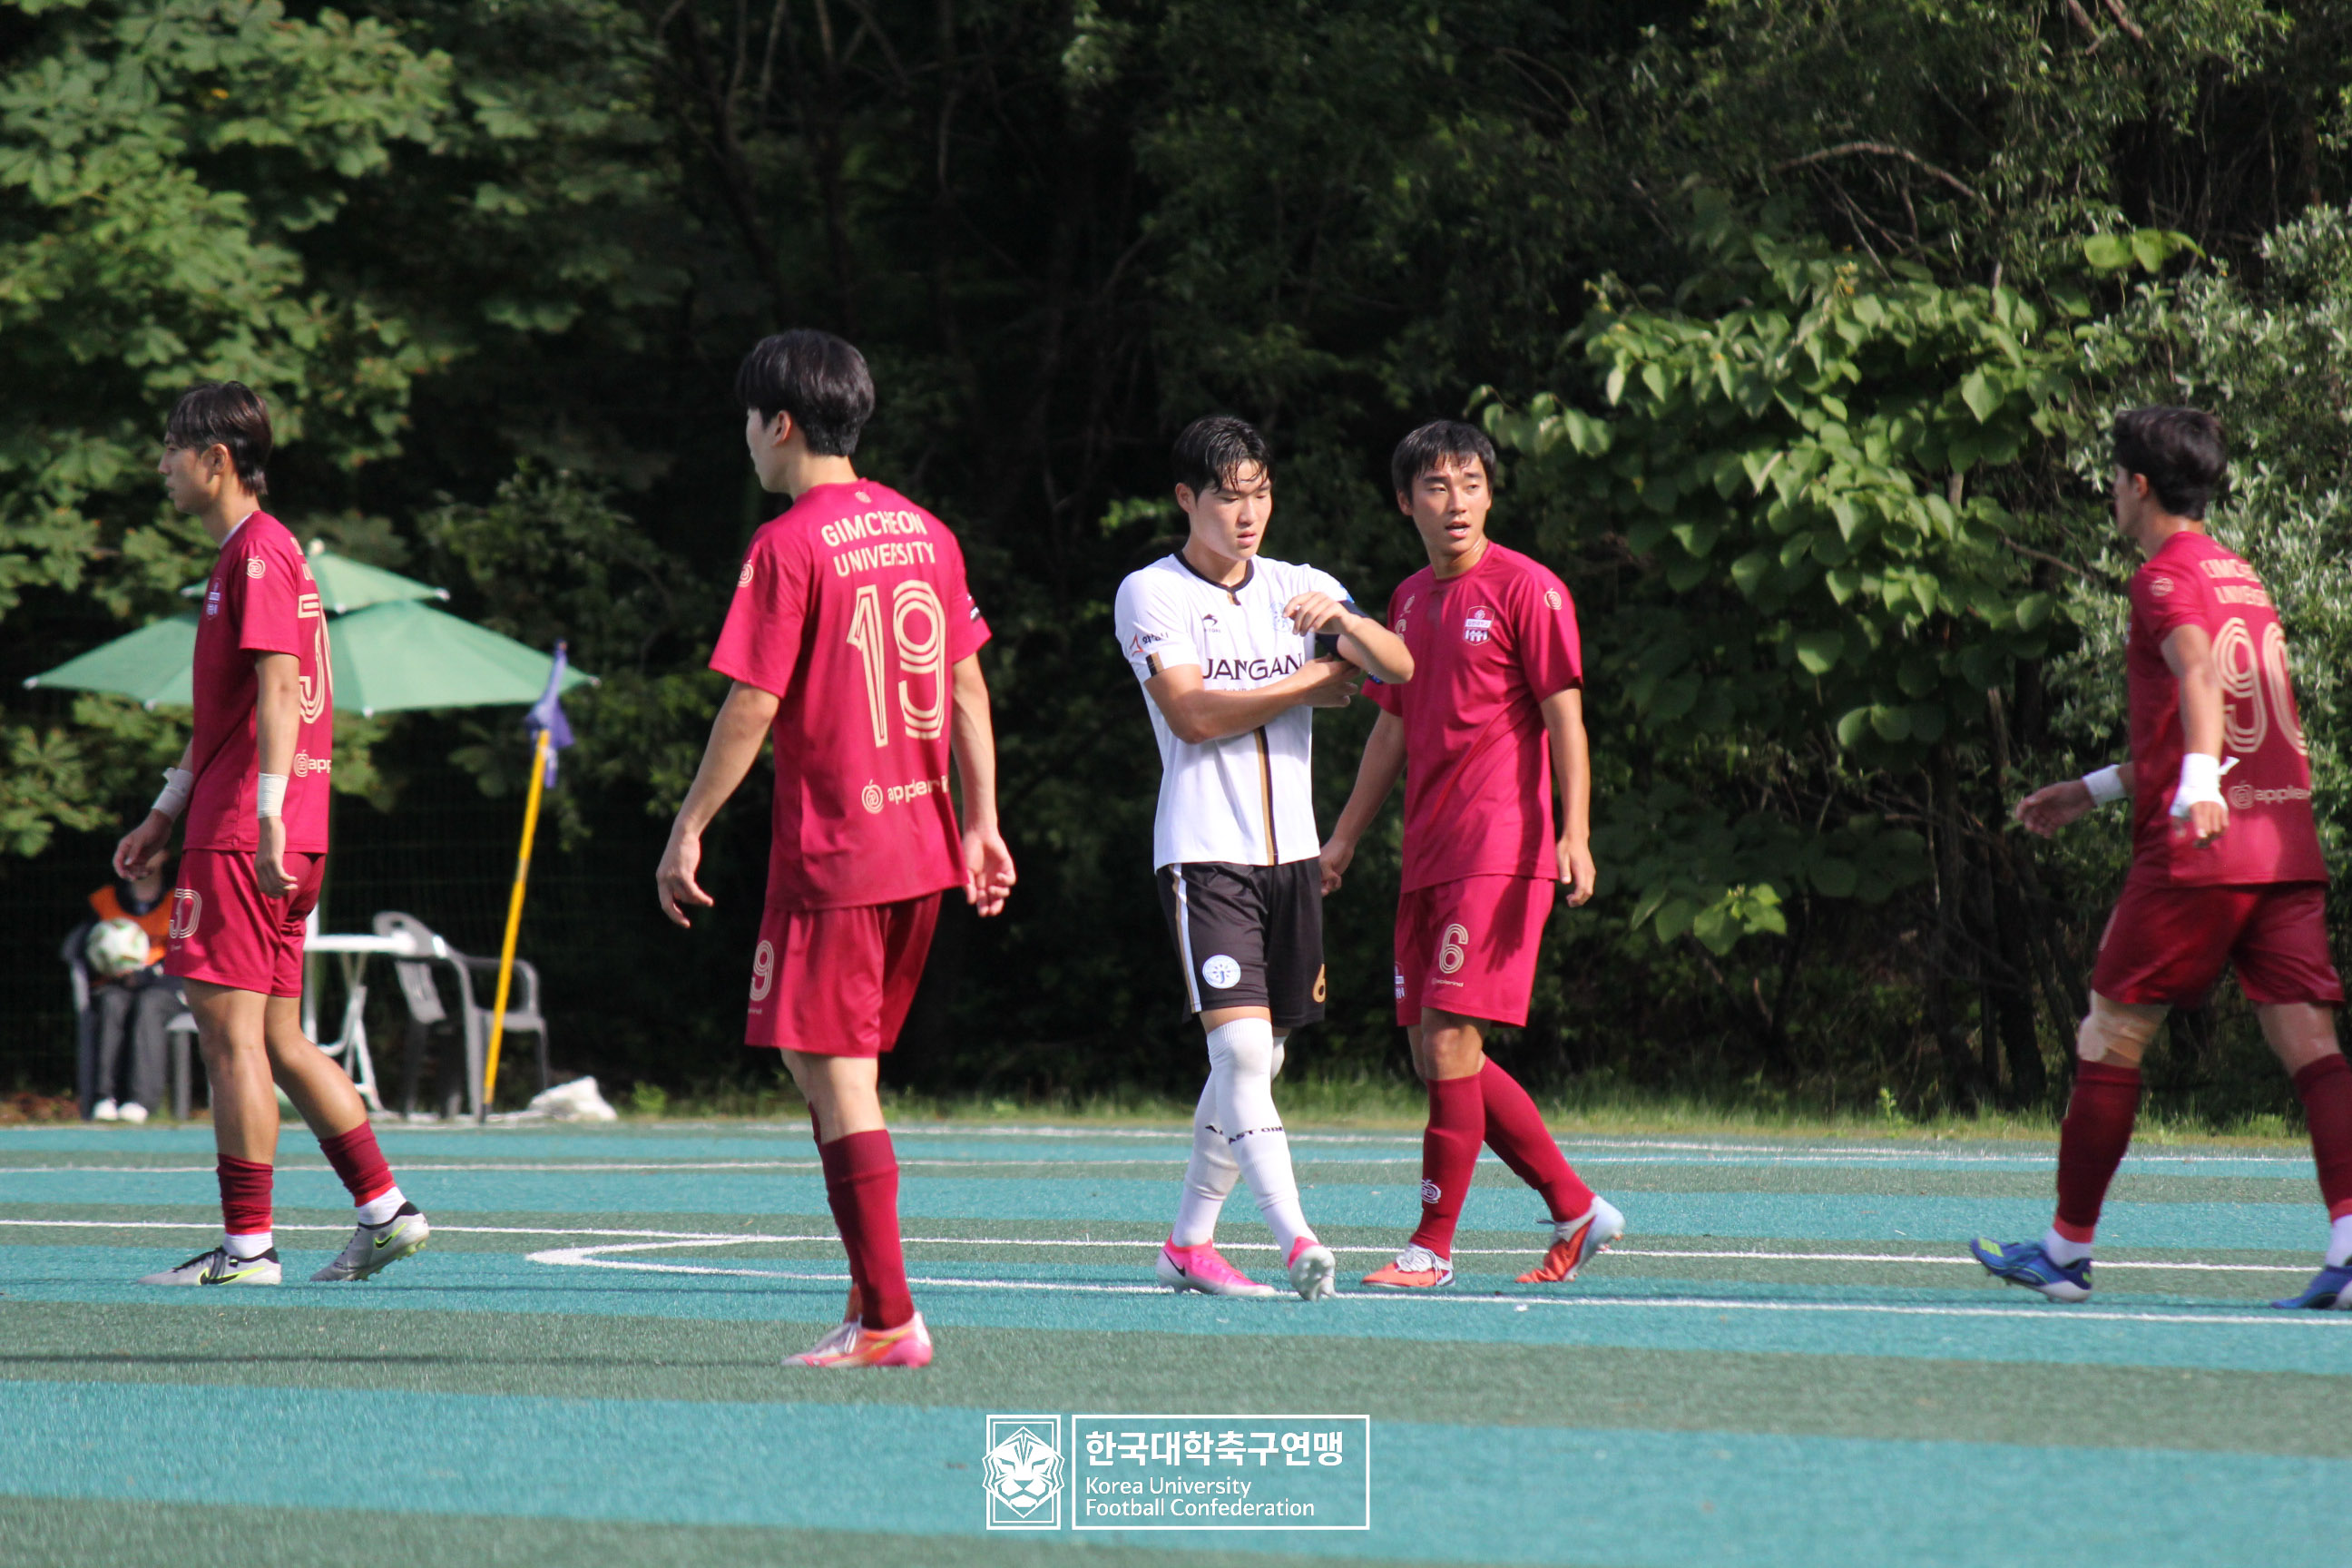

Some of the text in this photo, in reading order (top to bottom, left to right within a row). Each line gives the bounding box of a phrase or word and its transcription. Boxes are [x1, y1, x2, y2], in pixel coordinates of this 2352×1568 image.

[820, 510, 928, 547] GIMCHEON
[833, 541, 936, 577] UNIVERSITY
[847, 579, 946, 749] 19
[1202, 652, 1303, 681] JANGAN
[2210, 616, 2309, 757] 90
[1438, 923, 1469, 975] 6
[1312, 963, 1327, 1004] 6
